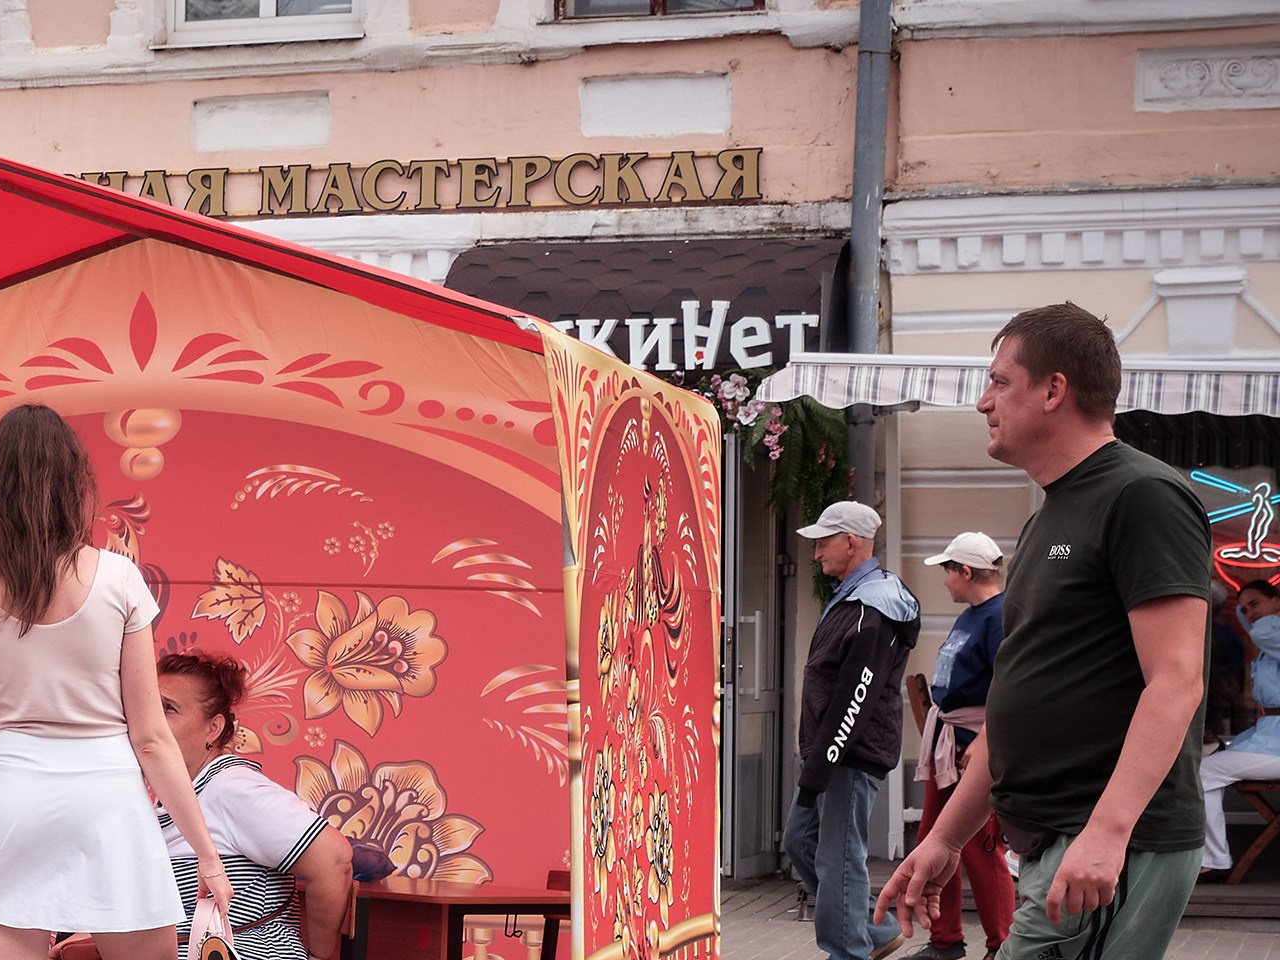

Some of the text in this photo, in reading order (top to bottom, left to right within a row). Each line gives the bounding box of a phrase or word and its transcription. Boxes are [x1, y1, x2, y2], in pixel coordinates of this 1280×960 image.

[258, 147, 764, 216] МАСТЕРСКАЯ
[1049, 545, 1071, 556] BOSS
[826, 666, 874, 763] BOMING
